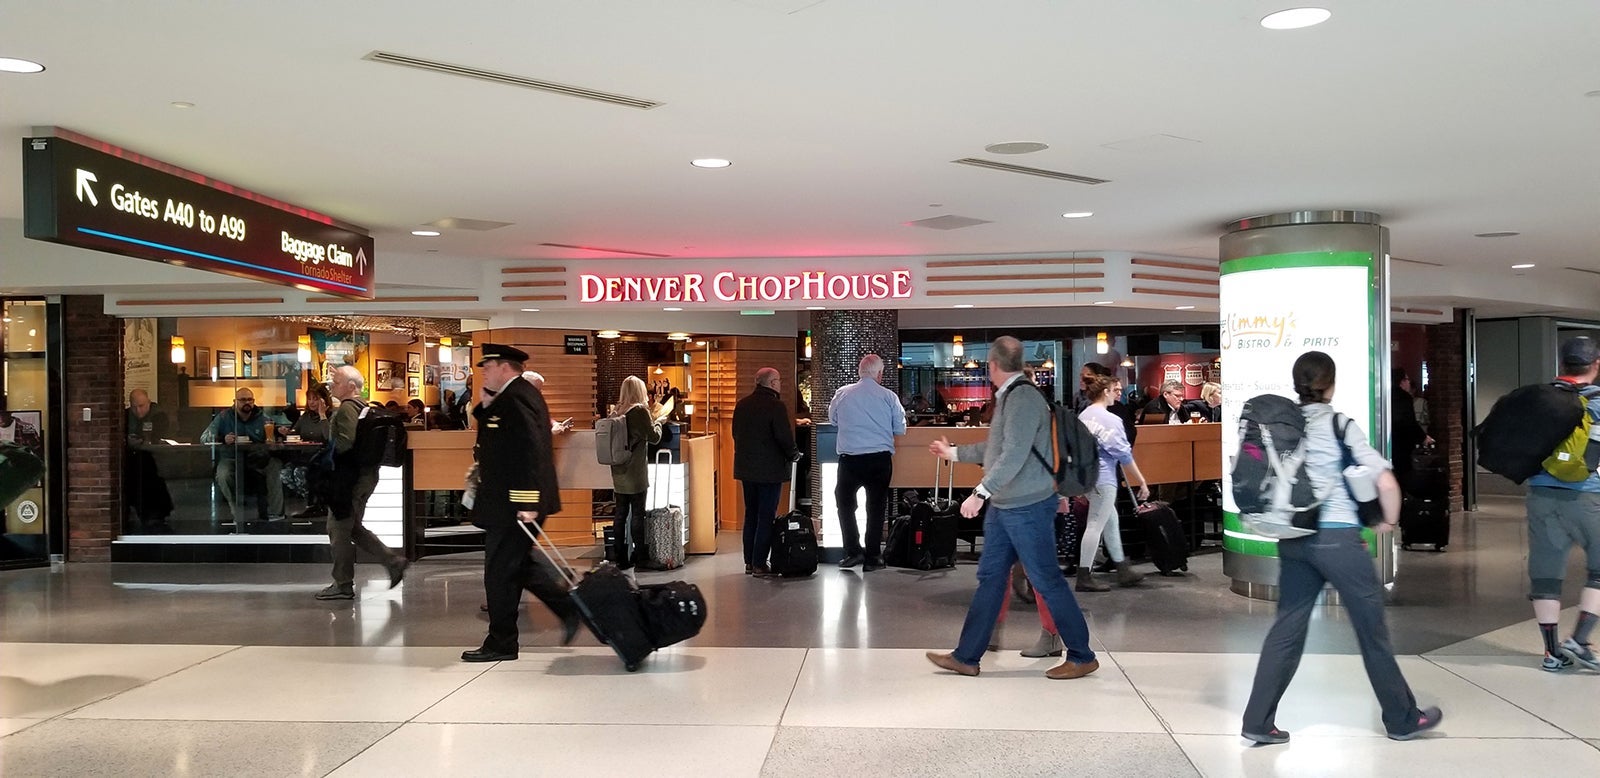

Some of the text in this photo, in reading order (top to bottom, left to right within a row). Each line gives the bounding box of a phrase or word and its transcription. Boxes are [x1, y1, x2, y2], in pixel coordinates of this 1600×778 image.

[110, 183, 246, 242] Gates A40 to A99
[281, 230, 353, 268] Baggage Claim
[301, 261, 352, 284] Tornado Shelter
[579, 272, 706, 304] DENVER
[1237, 338, 1271, 350] BISTRO
